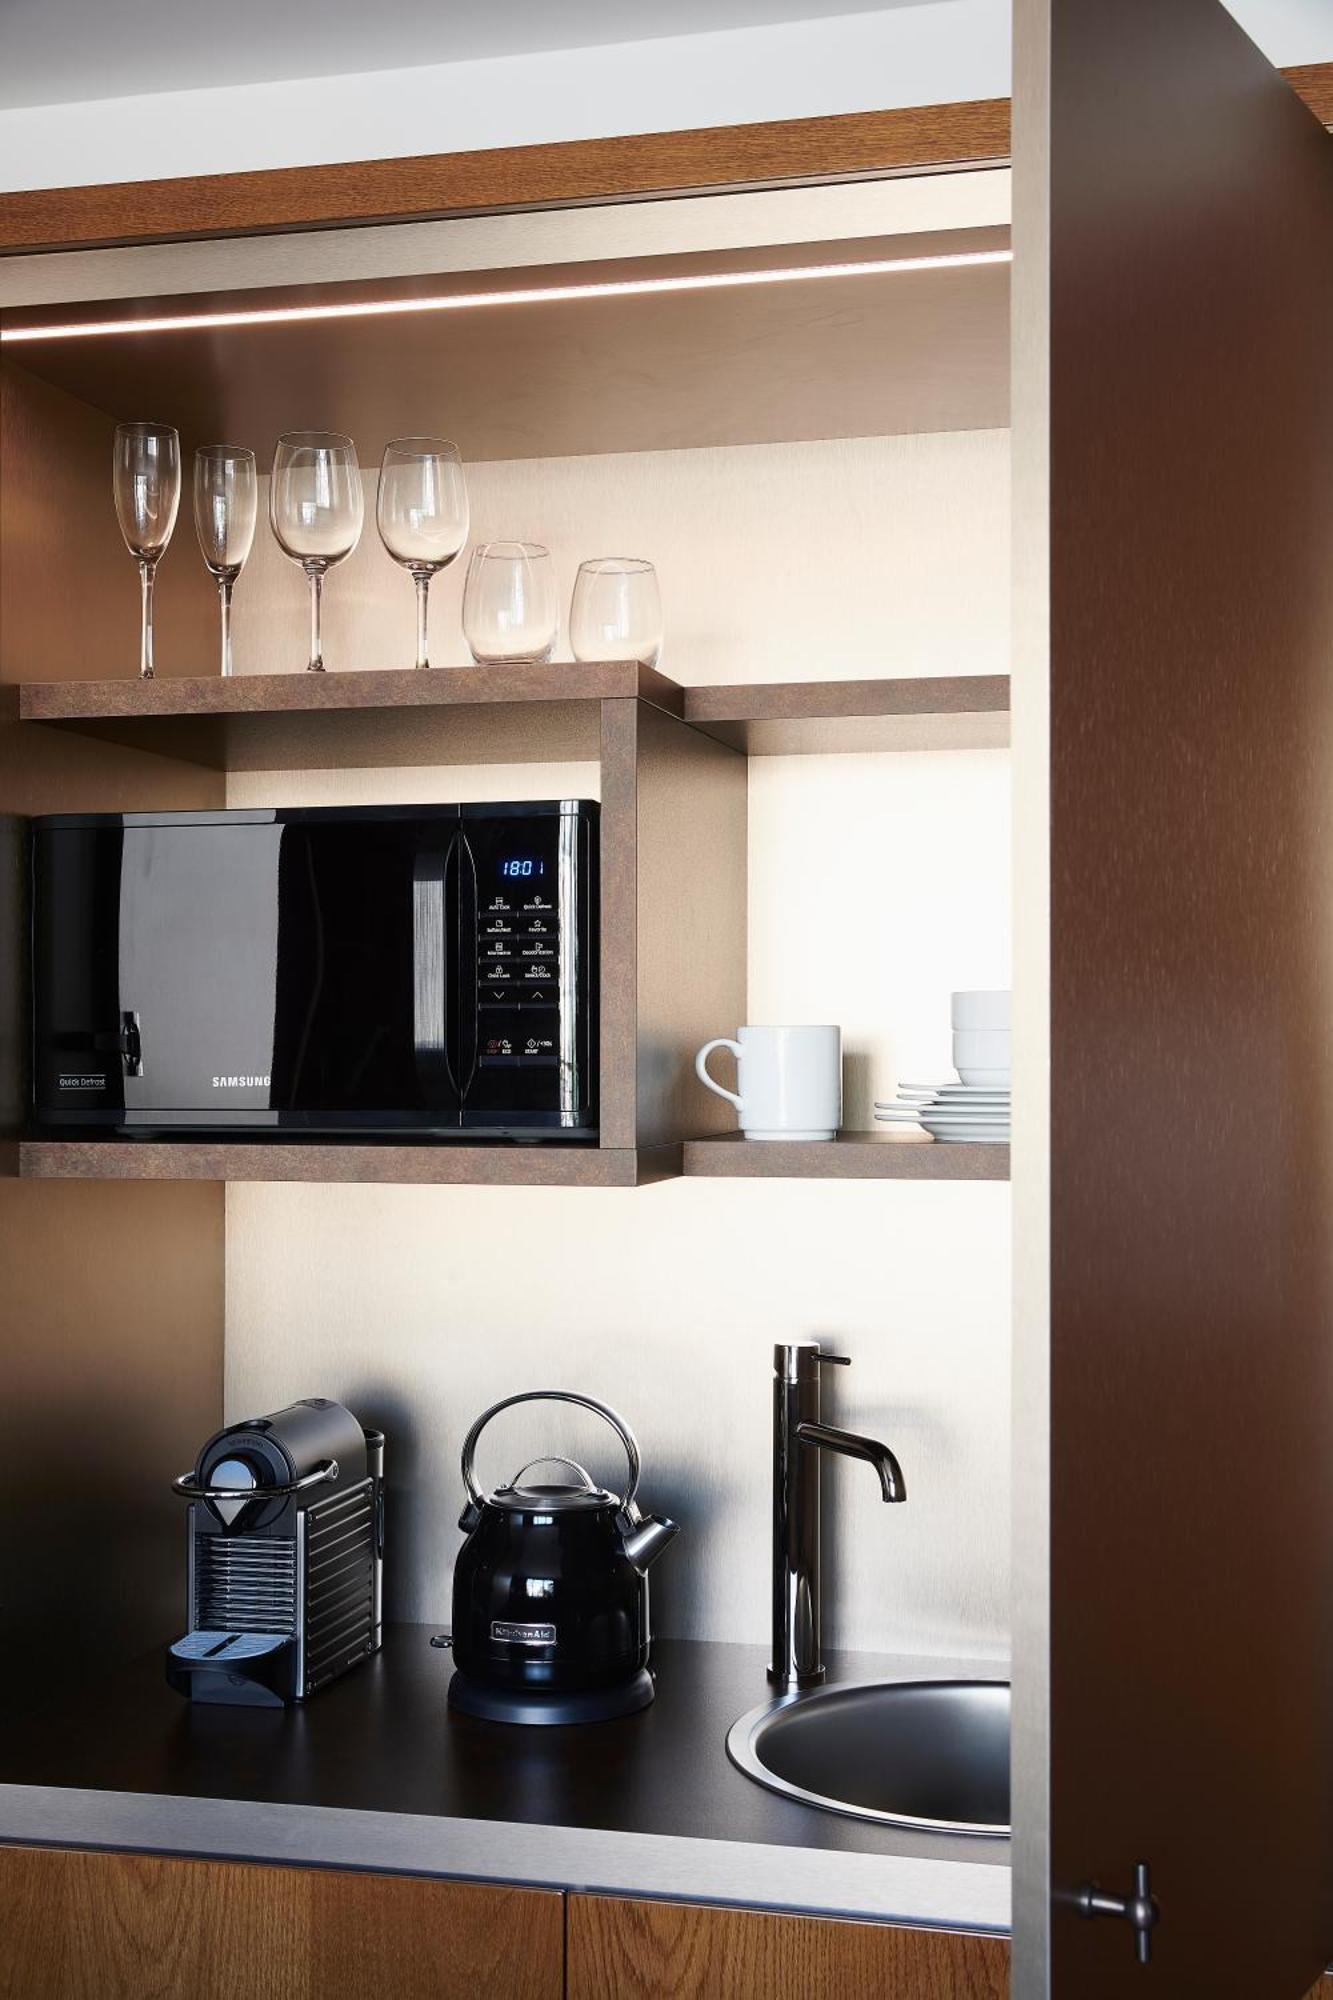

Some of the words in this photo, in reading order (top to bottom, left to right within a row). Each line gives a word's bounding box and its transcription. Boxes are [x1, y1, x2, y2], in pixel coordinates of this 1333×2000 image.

[59, 1078, 80, 1087] Quick
[80, 1078, 106, 1086] Defrost
[212, 1076, 271, 1088] SAMSUNG
